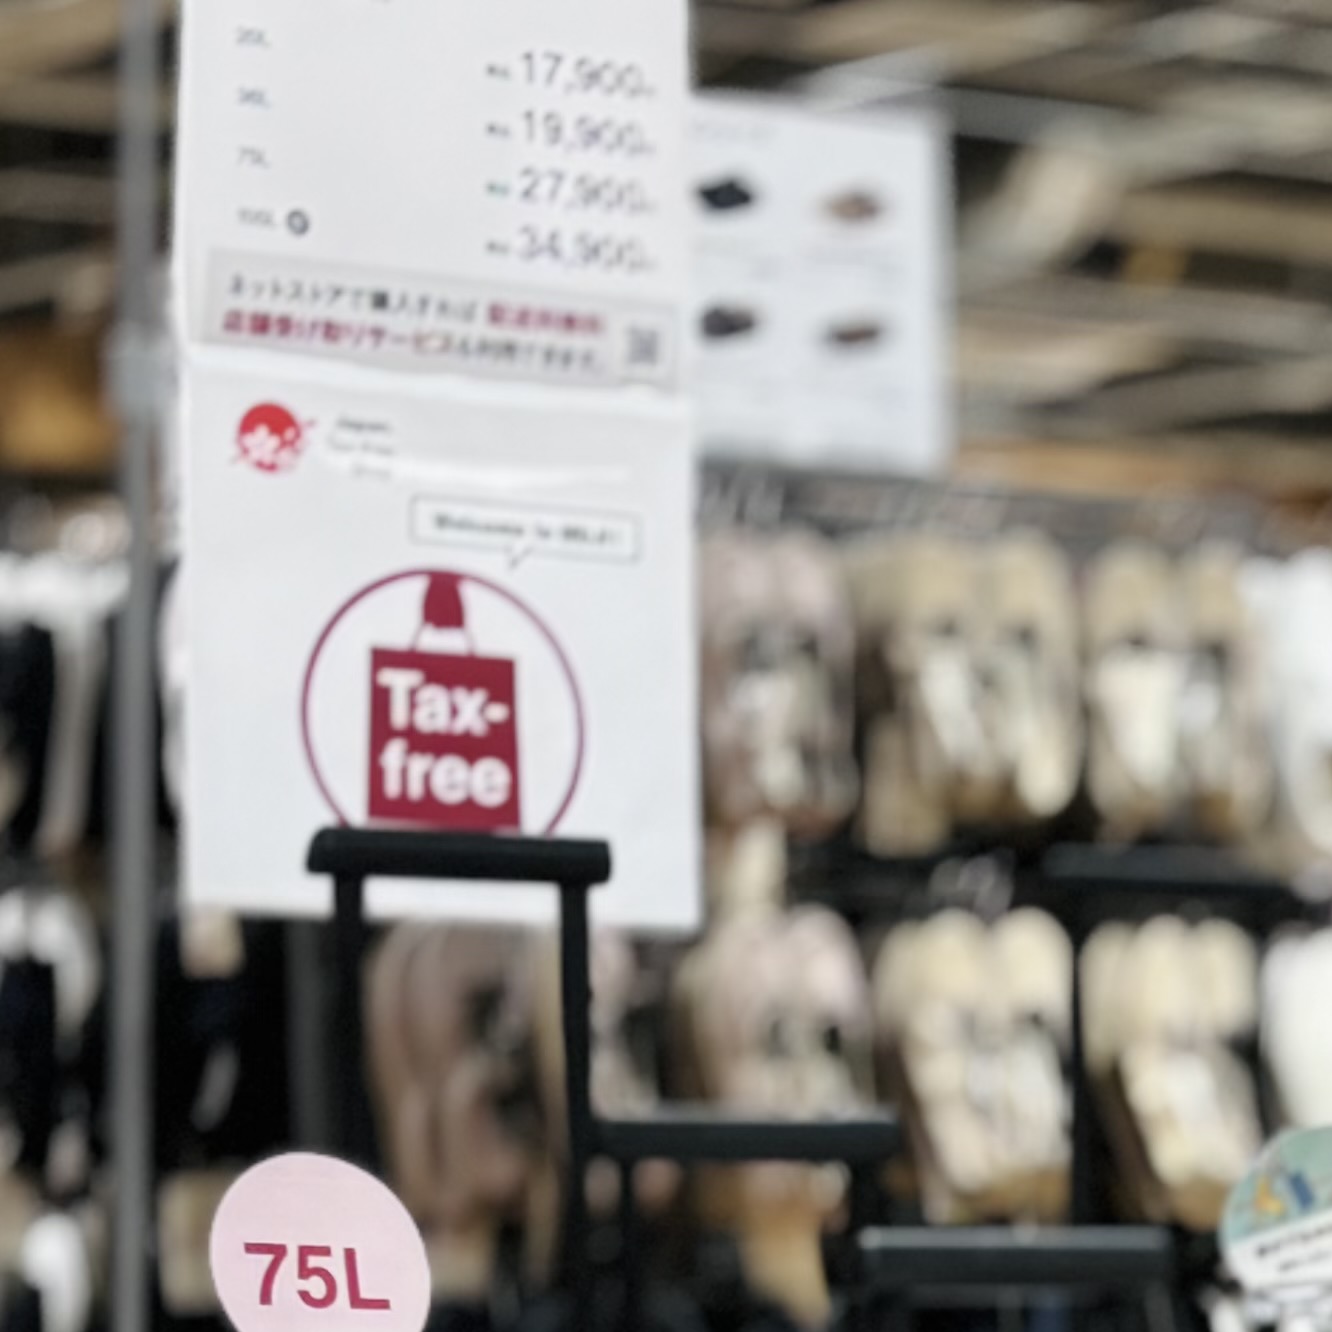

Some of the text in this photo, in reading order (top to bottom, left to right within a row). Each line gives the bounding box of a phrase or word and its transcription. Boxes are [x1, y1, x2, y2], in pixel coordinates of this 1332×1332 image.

[375, 665, 510, 737] Tax-
[379, 737, 512, 808] free
[243, 1241, 391, 1310] 75L
